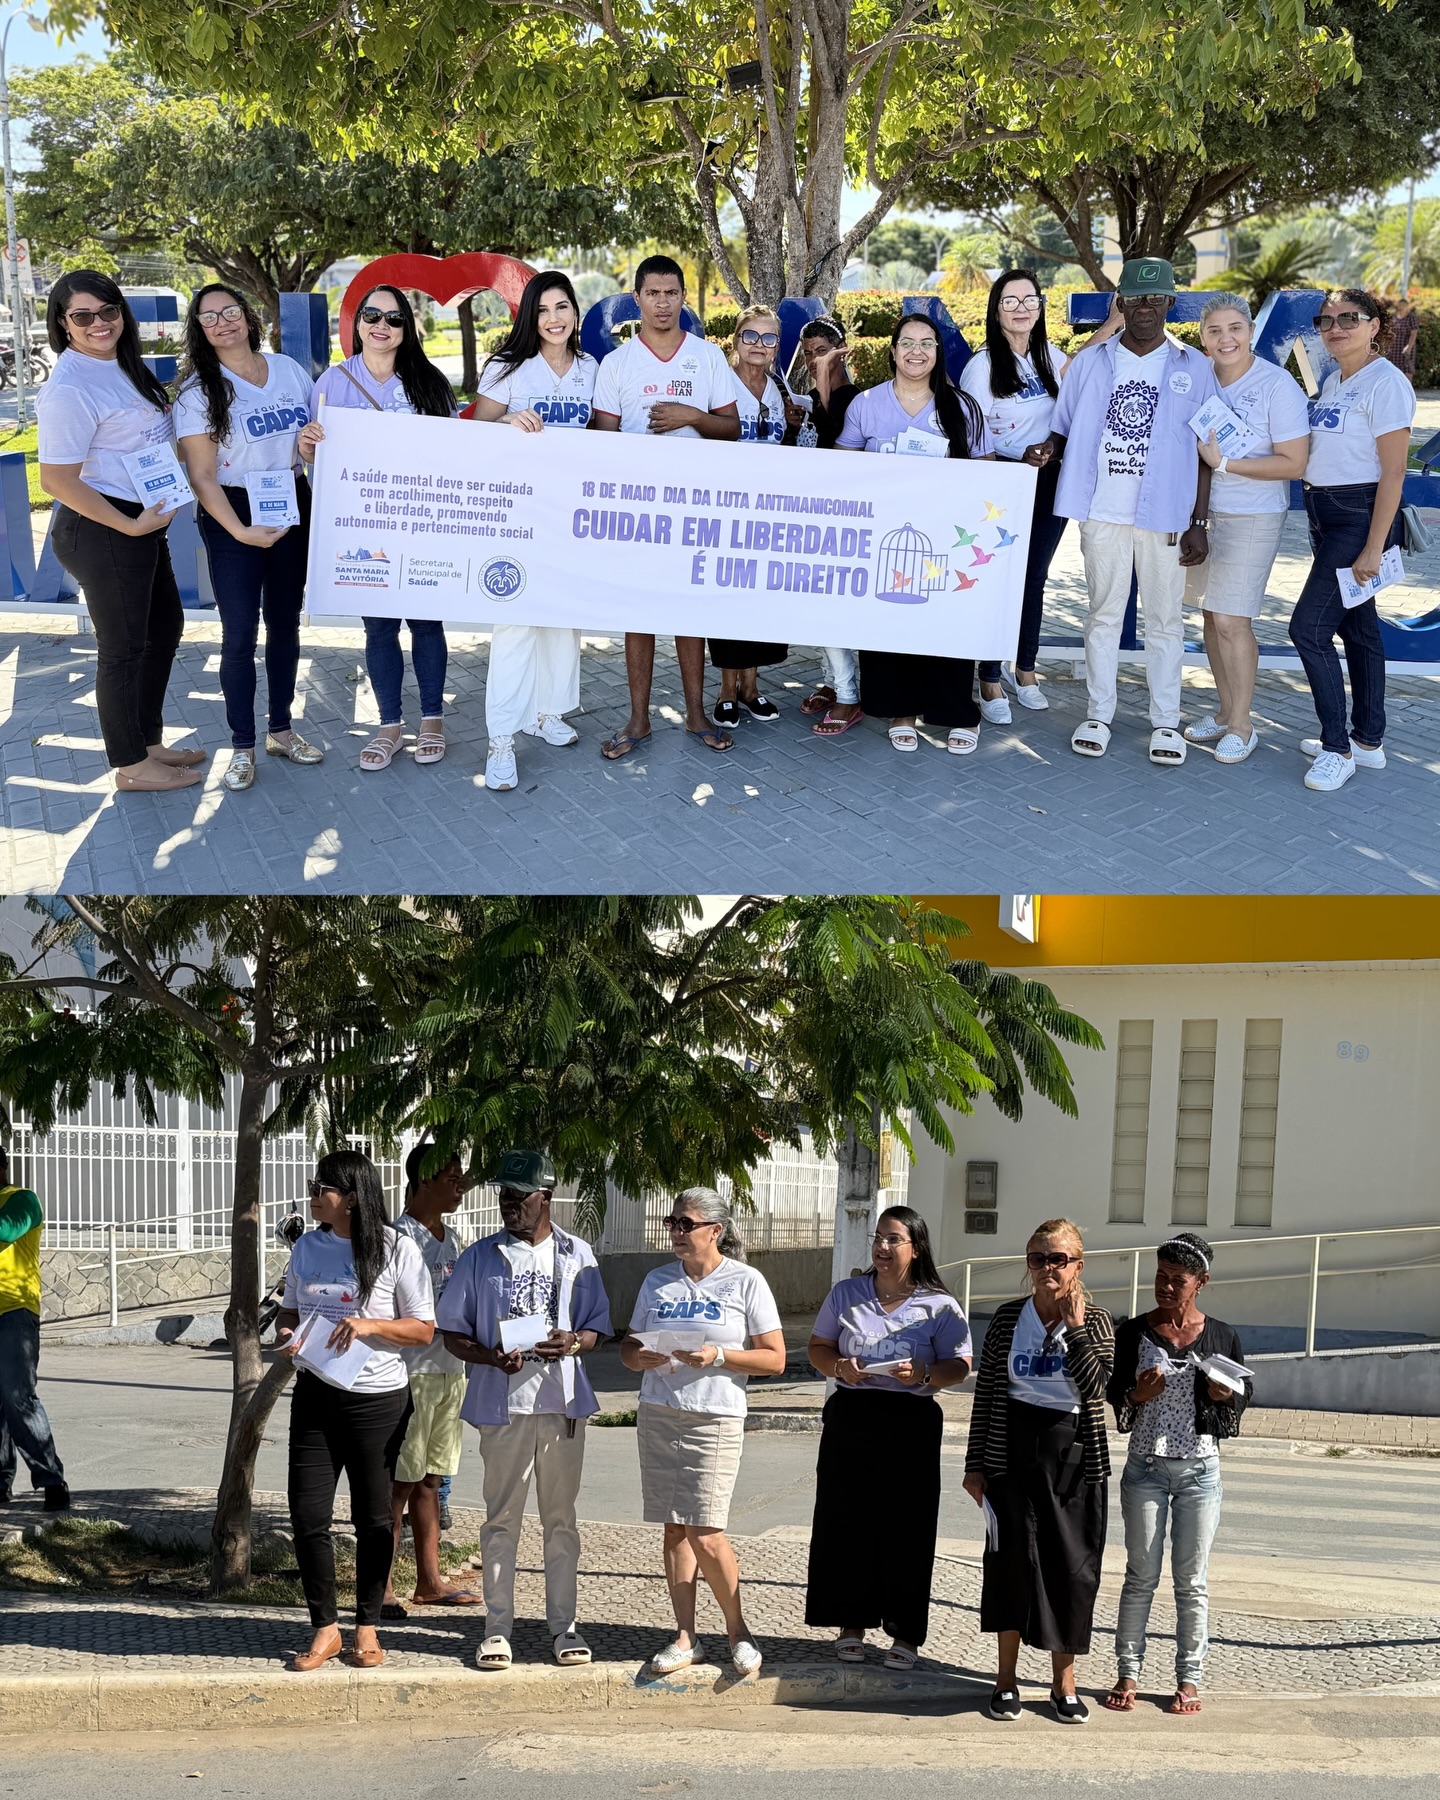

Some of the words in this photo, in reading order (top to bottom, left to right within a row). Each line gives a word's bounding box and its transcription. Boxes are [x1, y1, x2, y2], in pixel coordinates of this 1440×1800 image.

[671, 380, 692, 389] IGOR
[675, 388, 693, 397] IAN
[246, 407, 309, 437] CAPS
[533, 402, 589, 424] CAPS
[1105, 441, 1125, 454] Sou
[1126, 443, 1149, 457] CA
[1108, 458, 1127, 467] sou
[1129, 457, 1146, 467] liv
[1108, 466, 1137, 477] para
[340, 468, 349, 481] A
[352, 468, 388, 484] saúde
[391, 473, 433, 488] mental
[437, 476, 463, 490] deve
[466, 480, 485, 492] ser
[489, 481, 533, 496] cuidada
[360, 488, 385, 499] com
[388, 488, 463, 506] acolhimento,
[467, 493, 513, 510] respeito
[581, 480, 595, 497] 18
[600, 482, 616, 499] DE
[620, 484, 656, 502] MAIO
[664, 486, 686, 505] DIA
[692, 489, 711, 507] DA
[716, 490, 749, 510] LUTA
[755, 493, 875, 519] ANTIMANICOMIAL
[364, 504, 371, 513] e
[375, 502, 434, 520] liberdade,
[437, 506, 507, 523] promovendo
[334, 515, 397, 531] autonomia
[401, 520, 408, 531] e
[411, 518, 496, 538] pertencimento
[499, 525, 534, 540] social
[572, 508, 673, 545] CUIDAR
[682, 517, 721, 549] EM
[730, 519, 873, 560] LIBERDADE
[335, 566, 362, 574] SANTA
[363, 568, 390, 576] MARIA
[409, 557, 454, 568] Secretaria
[352, 575, 384, 583] VITÓRIA
[407, 577, 439, 587] Saúde
[408, 568, 451, 579] Municipal
[451, 570, 462, 579] de
[691, 550, 706, 585] É
[715, 556, 758, 590] UM
[766, 560, 869, 598] DIREITO
[1337, 1040, 1369, 1063] 89
[657, 1300, 721, 1321] CAPS
[849, 1335, 911, 1360] CAPS
